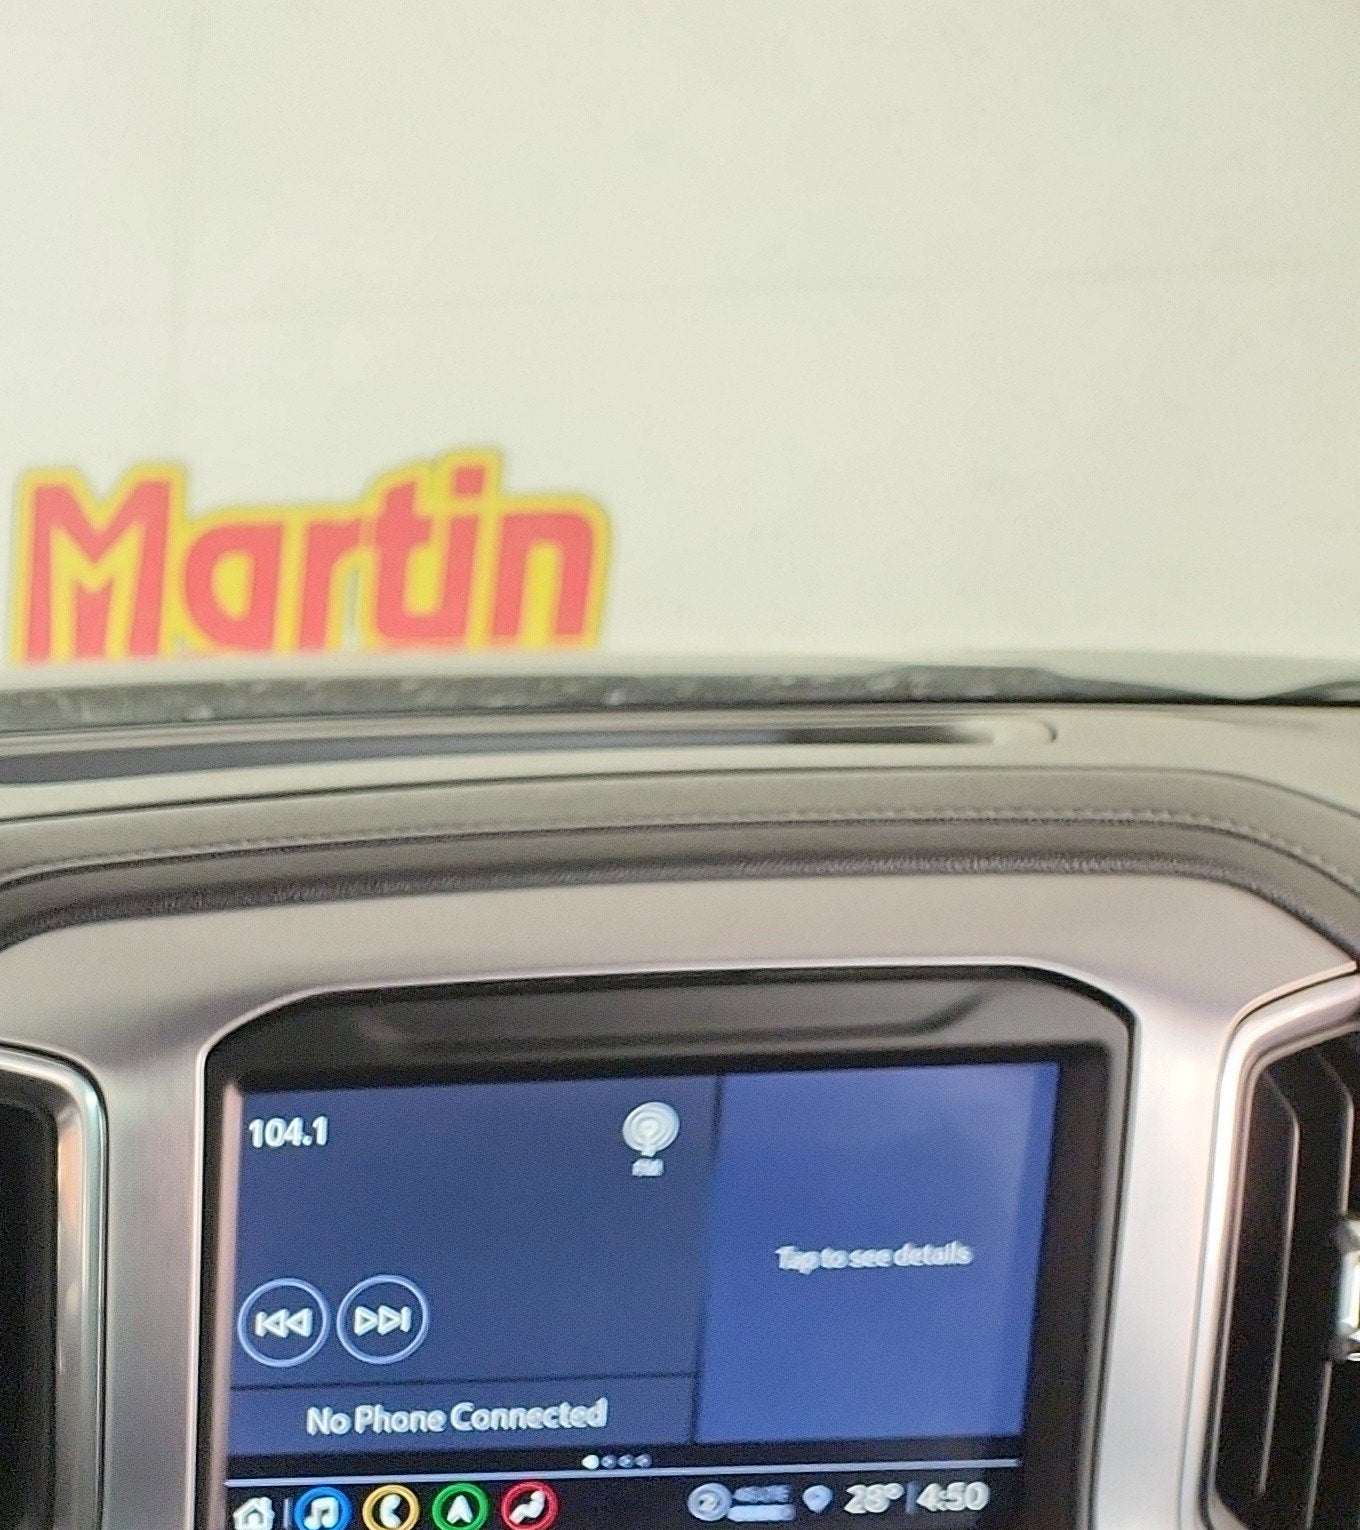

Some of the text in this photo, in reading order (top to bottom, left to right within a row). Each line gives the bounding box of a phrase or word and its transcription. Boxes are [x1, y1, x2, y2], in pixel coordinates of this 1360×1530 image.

[12, 451, 610, 667] Martin
[248, 1115, 329, 1148] 104.1
[775, 1240, 974, 1275] Tap to see details
[306, 1398, 608, 1435] No Phone Connected
